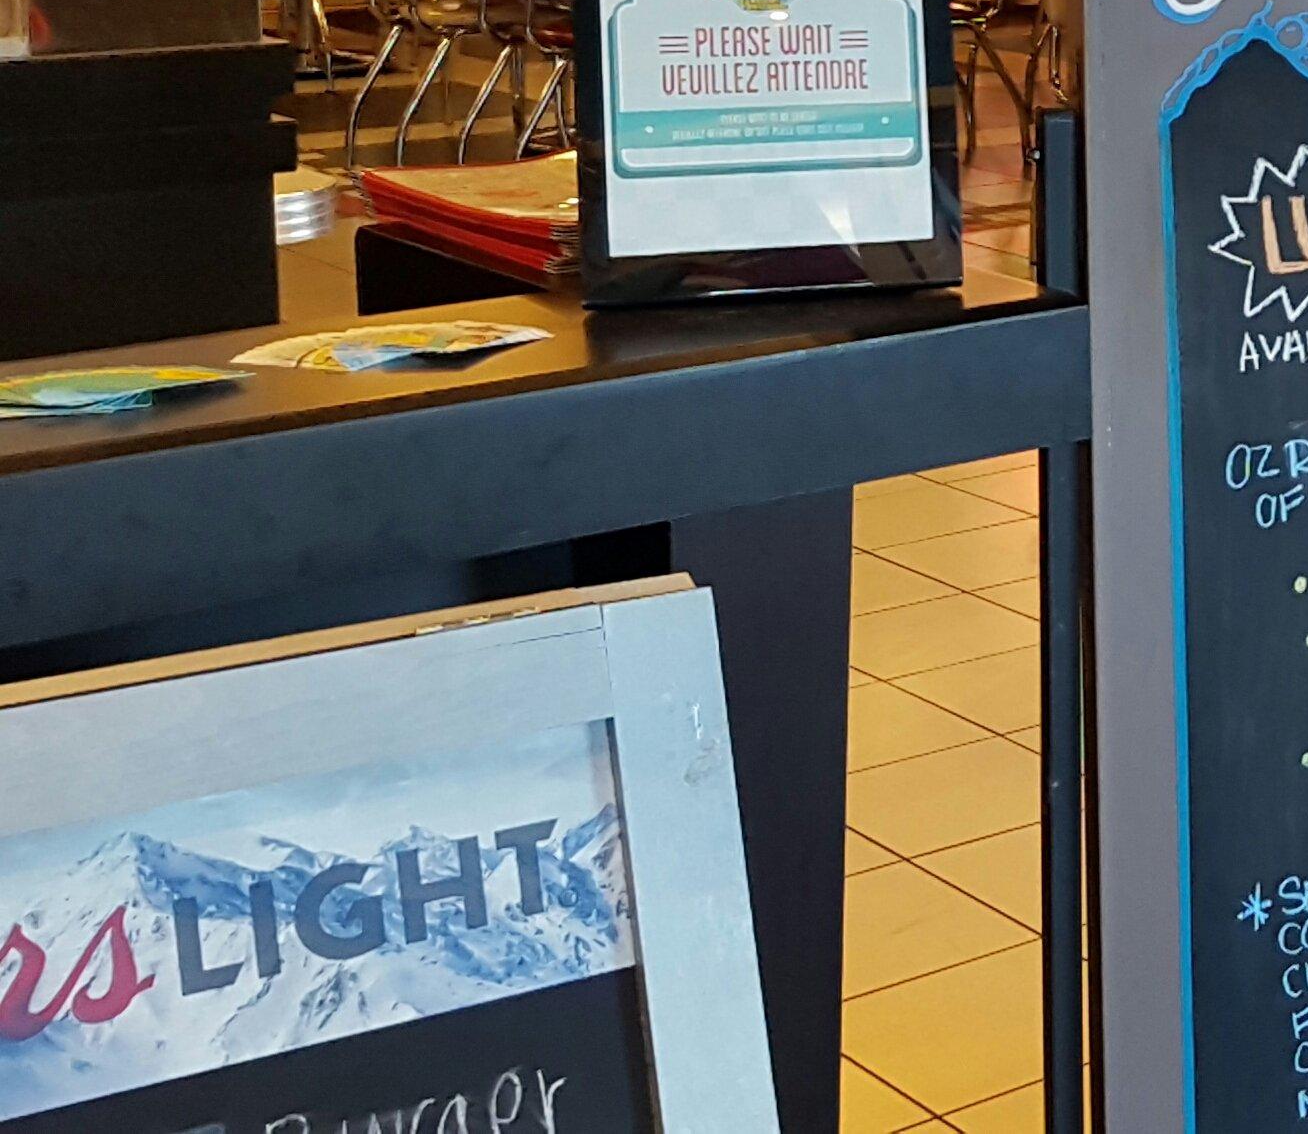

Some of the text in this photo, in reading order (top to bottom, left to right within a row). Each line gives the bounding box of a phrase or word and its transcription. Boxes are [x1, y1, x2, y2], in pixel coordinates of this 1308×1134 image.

[694, 23, 832, 57] PLEASE WAIT
[661, 58, 869, 96] VEUILLEZ ATTENDRE
[1224, 439, 1281, 490] OZ
[1255, 489, 1306, 529] OF
[172, 818, 559, 997] LIGHT
